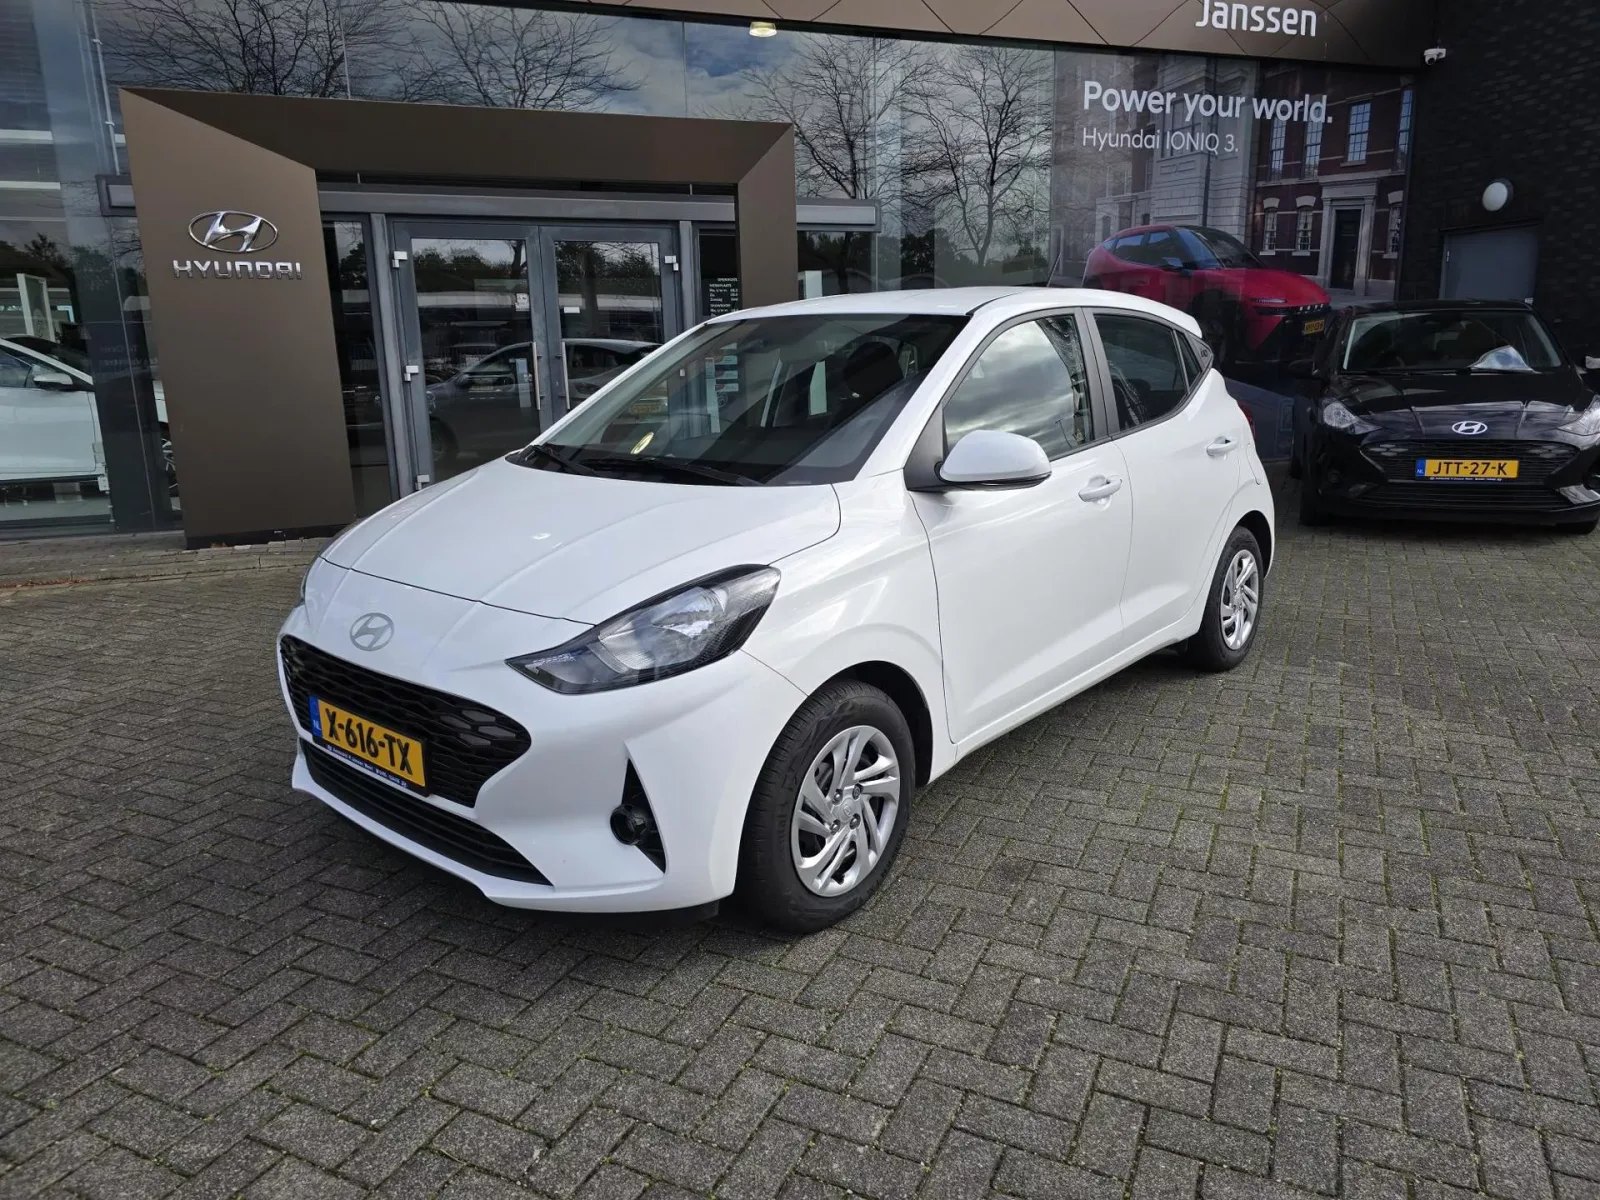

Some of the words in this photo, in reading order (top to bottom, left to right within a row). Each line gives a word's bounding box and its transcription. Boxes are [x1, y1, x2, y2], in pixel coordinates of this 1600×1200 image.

[1195, 0, 1317, 37] Janssen
[1083, 81, 1177, 114] Power
[1183, 91, 1245, 122] your
[1252, 94, 1333, 124] world.
[1082, 127, 1161, 151] Hyundai
[1166, 131, 1220, 155] IONIQ
[1224, 134, 1239, 152] 3.
[173, 260, 302, 280] HYUNDAI
[1433, 461, 1508, 476] JTT-27-K
[325, 707, 413, 776] X-616-TX
